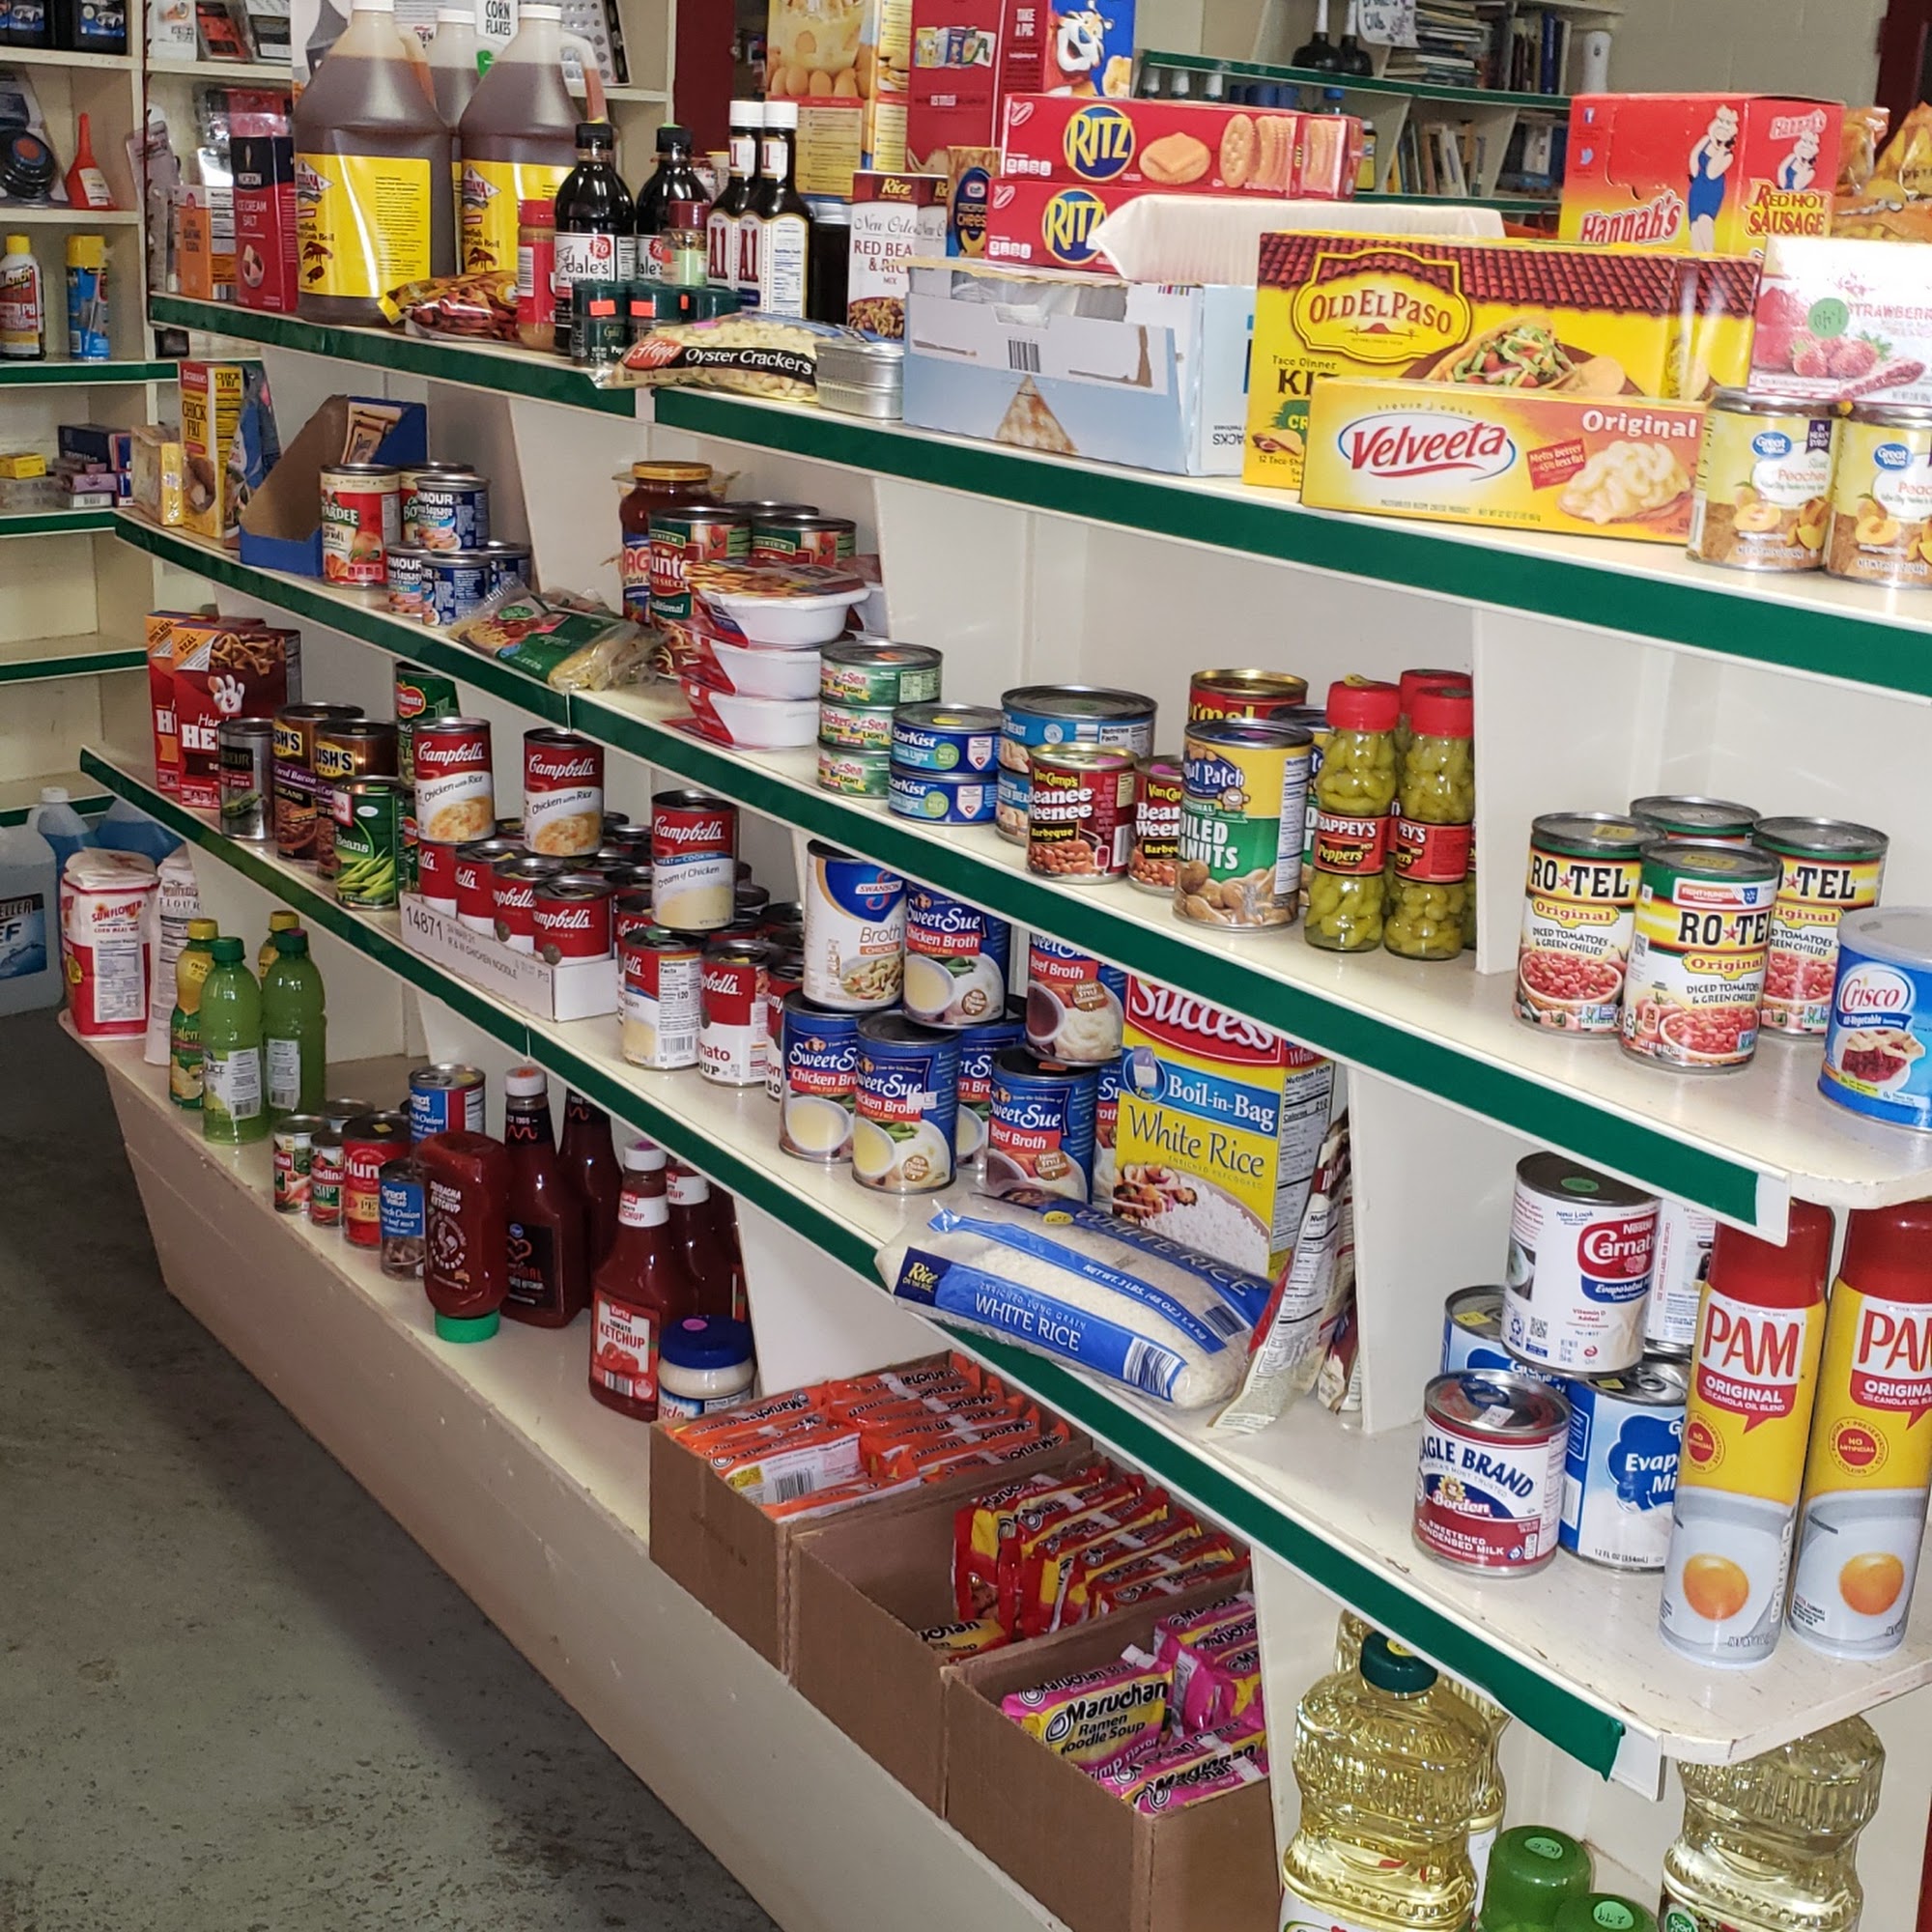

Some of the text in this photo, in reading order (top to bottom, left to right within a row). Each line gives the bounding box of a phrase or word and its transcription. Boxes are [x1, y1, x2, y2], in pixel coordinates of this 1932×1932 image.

[485, 0, 511, 20] CORN
[486, 19, 512, 37] FLAKES
[1068, 114, 1132, 169] RITZ
[882, 178, 912, 195] Rice
[1580, 190, 1682, 242] Hannah's
[1747, 209, 1826, 236] SAUSAGE
[854, 240, 881, 255] RED
[566, 254, 609, 274] dale's
[1309, 293, 1355, 326] OLD
[686, 349, 737, 367] Oyster
[738, 349, 813, 376] Crackers
[1272, 355, 1338, 370] Taco Dinner
[1277, 368, 1340, 396] KI
[1581, 410, 1697, 440] Original
[1352, 420, 1508, 470] Velveeta
[1754, 436, 1786, 448] Great
[1876, 448, 1908, 460] Great
[182, 724, 219, 752] HE
[1204, 763, 1244, 788] Patch
[424, 775, 483, 802] Chicken Rice
[531, 789, 592, 815] Chicken Rice
[1318, 844, 1364, 864] Peppers
[688, 866, 720, 877] Chicken
[859, 882, 900, 893] SWANSON
[1536, 900, 1611, 922] Original
[406, 905, 443, 942] 14871
[860, 925, 901, 944] Broth
[943, 935, 979, 949] Broth
[1532, 927, 1607, 947] DICED TOMATOES
[1780, 929, 1833, 948] TOMATOES
[1542, 939, 1604, 956] GREEN CHILIES
[1798, 941, 1828, 956] CHILIES
[1049, 962, 1084, 980] Broth
[1690, 956, 1762, 974] Original
[676, 991, 689, 1000] 120
[1687, 983, 1717, 995] DICED
[1841, 978, 1900, 1014] Crisco
[1702, 994, 1731, 1005] GREEN
[792, 1068, 838, 1087] Chicken
[1169, 1074, 1275, 1132] Boil-in-Bag
[1012, 1132, 1047, 1150] Broth
[1128, 1103, 1264, 1178] White Rice
[908, 1262, 939, 1285] Rice
[1083, 1264, 1099, 1276] NET
[976, 1293, 1082, 1352] WHITE RICE
[1027, 1296, 1052, 1316] LONG
[1056, 1312, 1087, 1331] GRAIN
[599, 1321, 646, 1350] KETCHUP
[1702, 1302, 1801, 1378] PAM
[1706, 1375, 1783, 1405] ORIGINAL
[1712, 1393, 1785, 1412] CANOLA OIL BLEND
[1874, 1395, 1907, 1406] CANOLA
[1848, 1436, 1863, 1447] NO
[1461, 1447, 1534, 1497] BRAND
[1434, 1491, 1491, 1515] Borden
[1429, 1519, 1486, 1546] SWEETENED
[1476, 1546, 1504, 1555] MILK
[1066, 1681, 1168, 1723] Maruchan
[1078, 1714, 1128, 1737] Ramen
[1108, 1721, 1146, 1740] Soup
